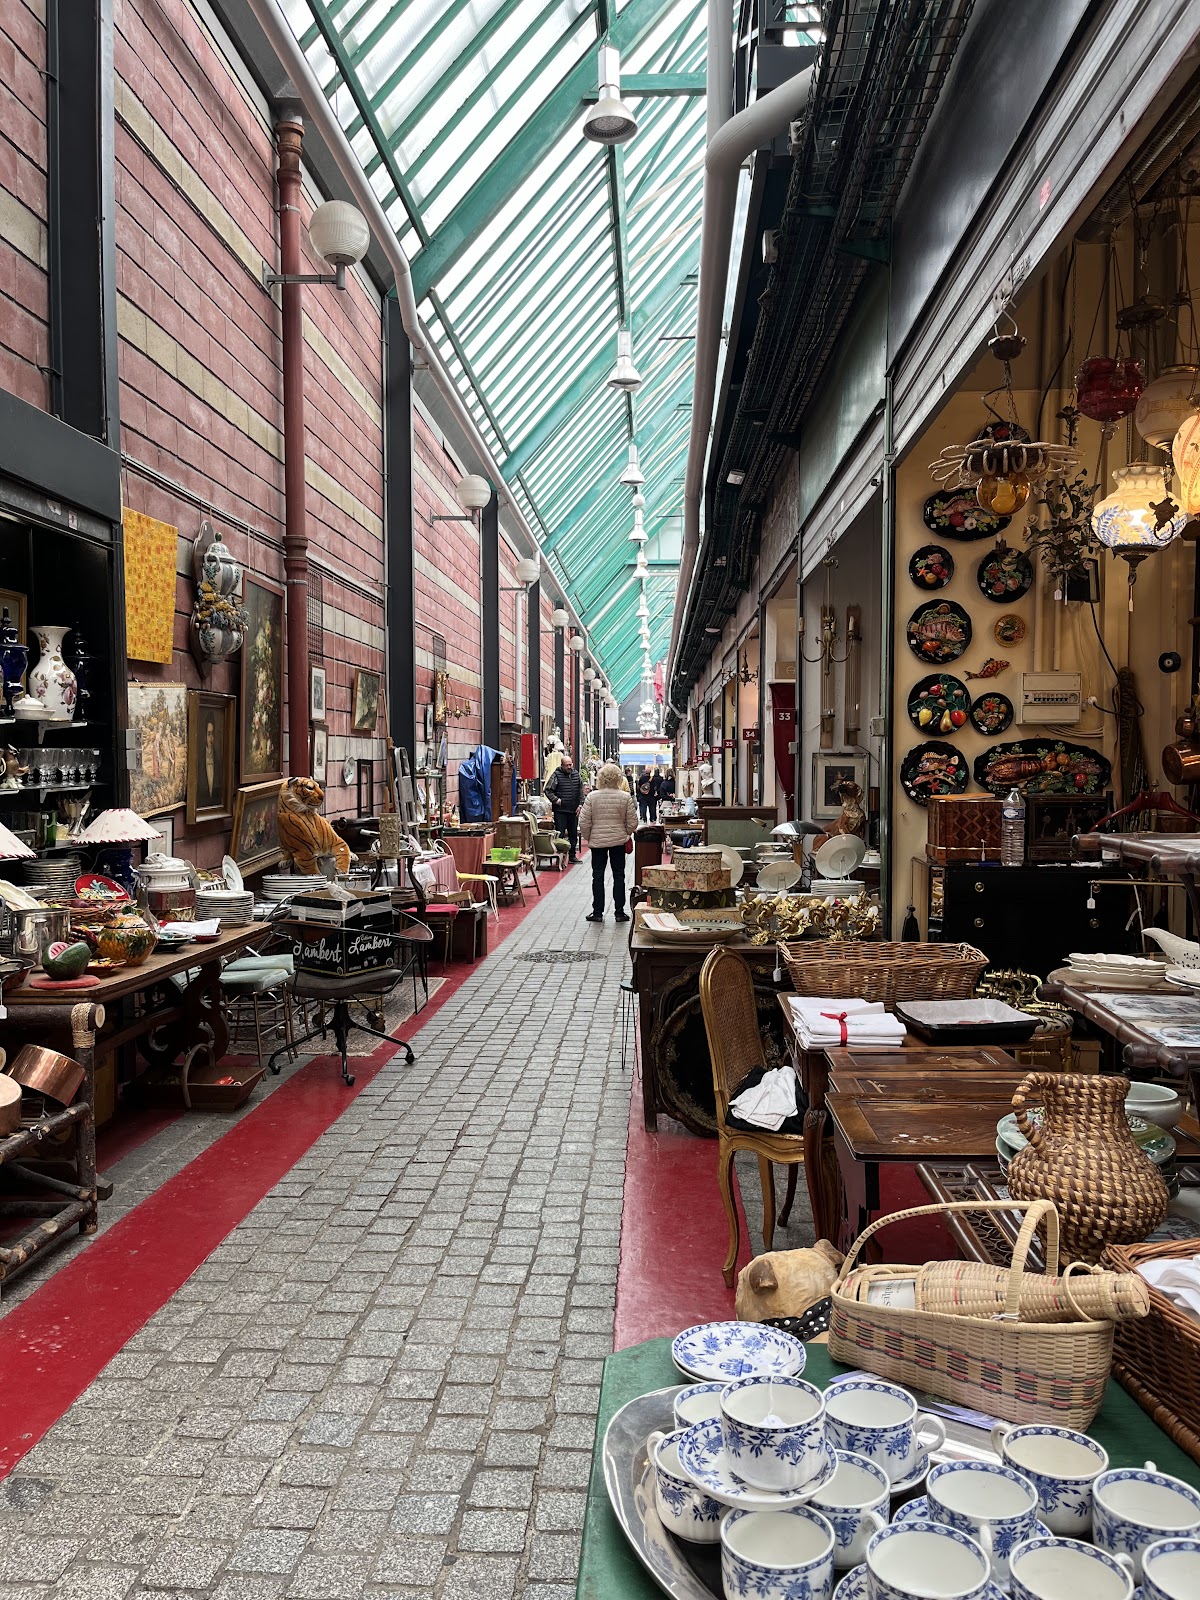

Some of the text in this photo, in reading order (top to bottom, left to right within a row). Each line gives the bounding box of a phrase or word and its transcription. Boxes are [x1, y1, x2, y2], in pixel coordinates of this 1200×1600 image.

[778, 712, 791, 720] 33
[292, 937, 343, 963] Lambert
[348, 935, 393, 955] Lambert
